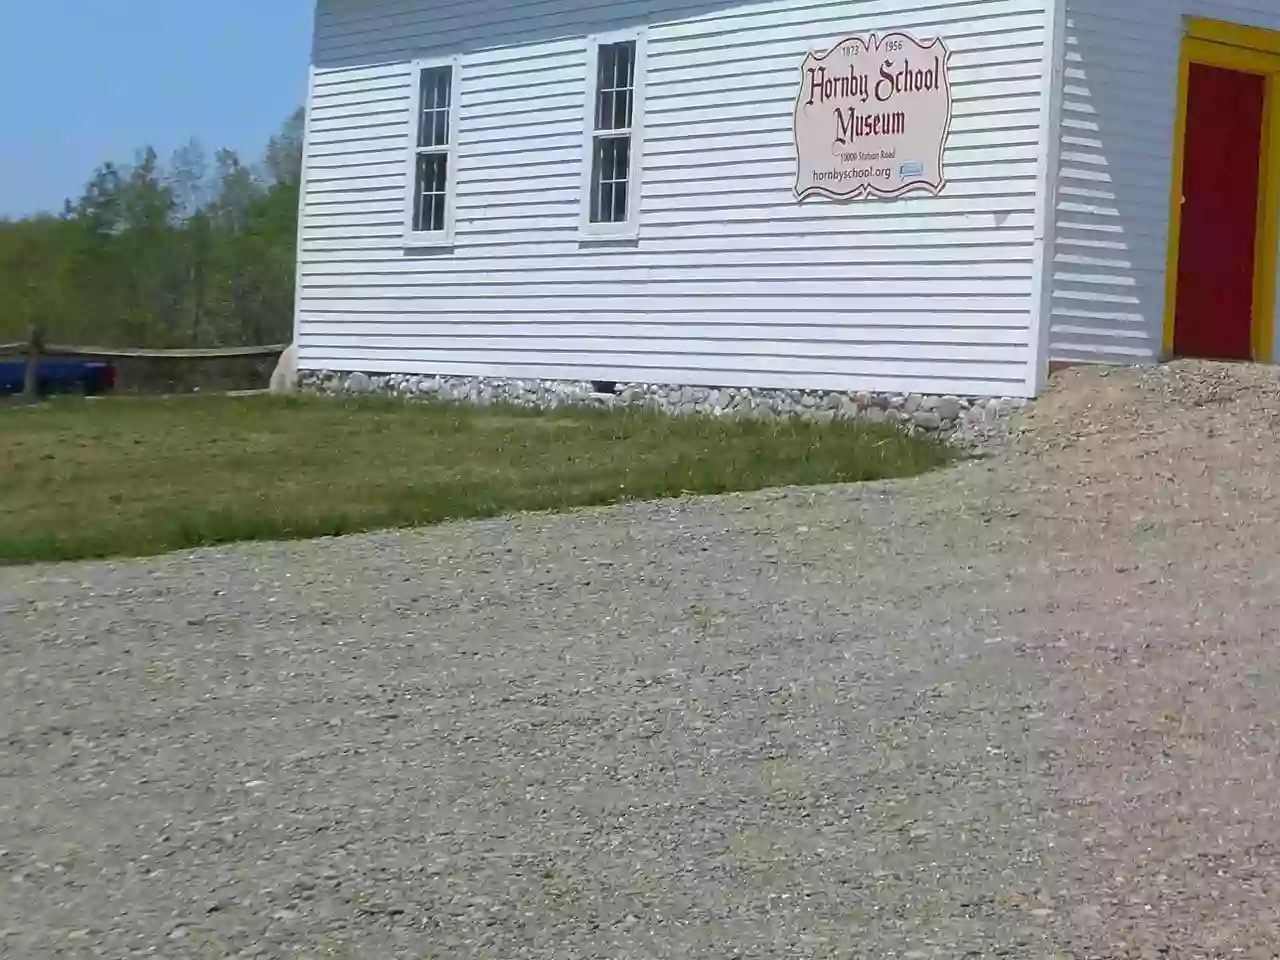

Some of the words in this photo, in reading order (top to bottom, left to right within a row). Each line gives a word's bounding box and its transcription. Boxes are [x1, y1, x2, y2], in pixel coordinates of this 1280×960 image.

[805, 64, 869, 105] Hornby
[875, 56, 939, 101] School
[832, 107, 905, 145] Museum
[813, 166, 891, 183] hornbyschool.org
